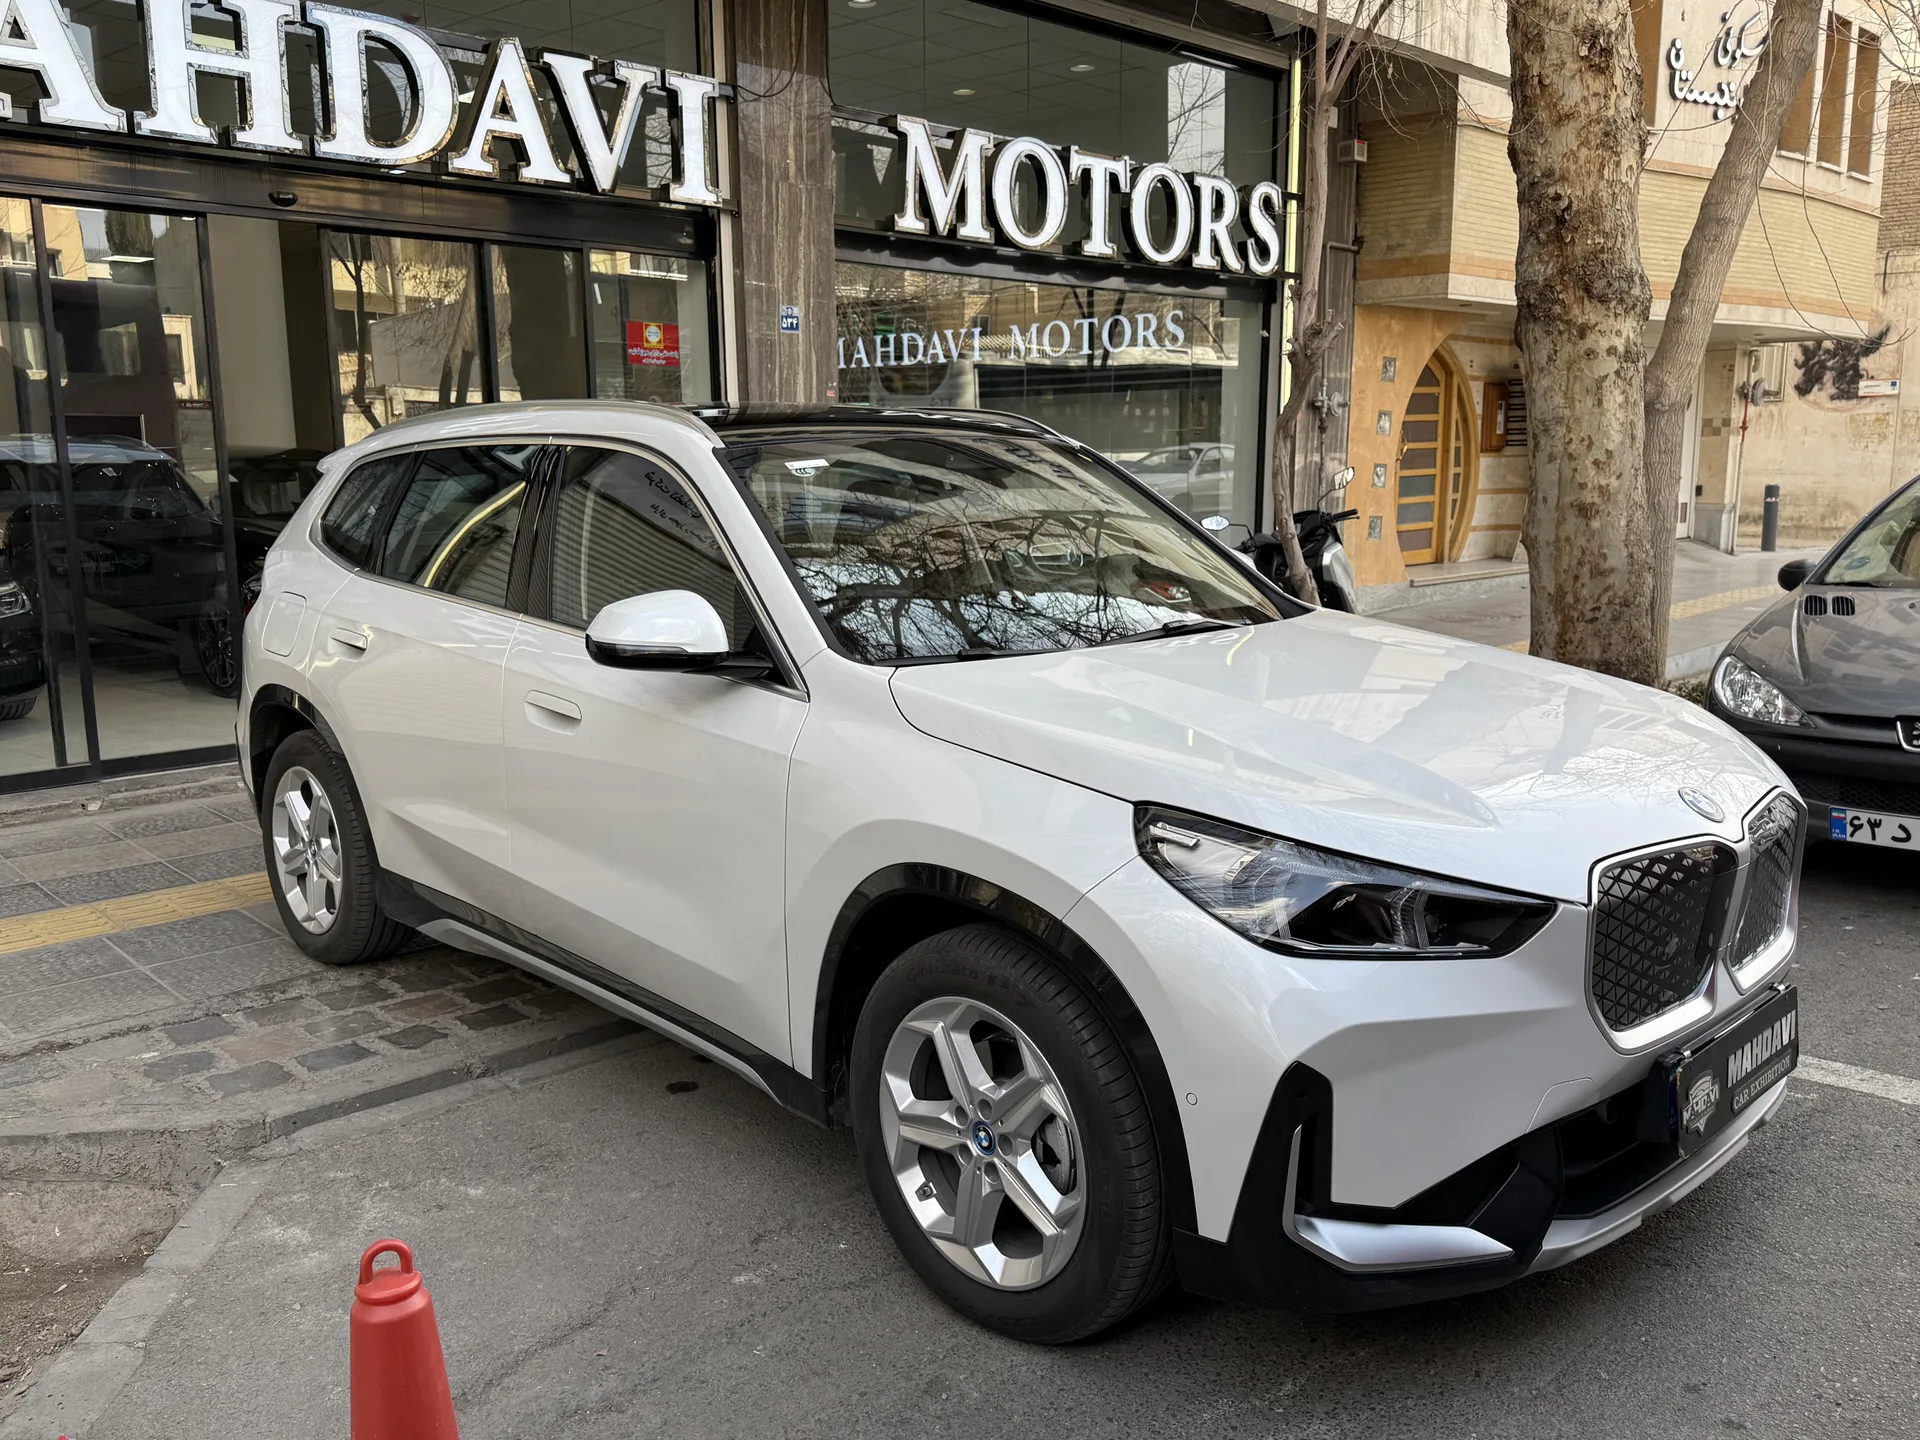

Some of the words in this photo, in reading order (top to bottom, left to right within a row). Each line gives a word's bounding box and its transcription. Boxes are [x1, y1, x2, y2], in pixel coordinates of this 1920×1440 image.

[0, 0, 724, 207] AHDAVI
[893, 113, 1284, 276] MOTORS
[1008, 309, 1186, 361] MOTORS
[1849, 815, 1882, 841] ۶۳
[1890, 823, 1912, 843] د
[906, 962, 979, 982] Cinturato
[1727, 1009, 1796, 1089] MAHDAVI
[1733, 1089, 1749, 1110] CAR
[1750, 1055, 1791, 1097] EXHIBITION
